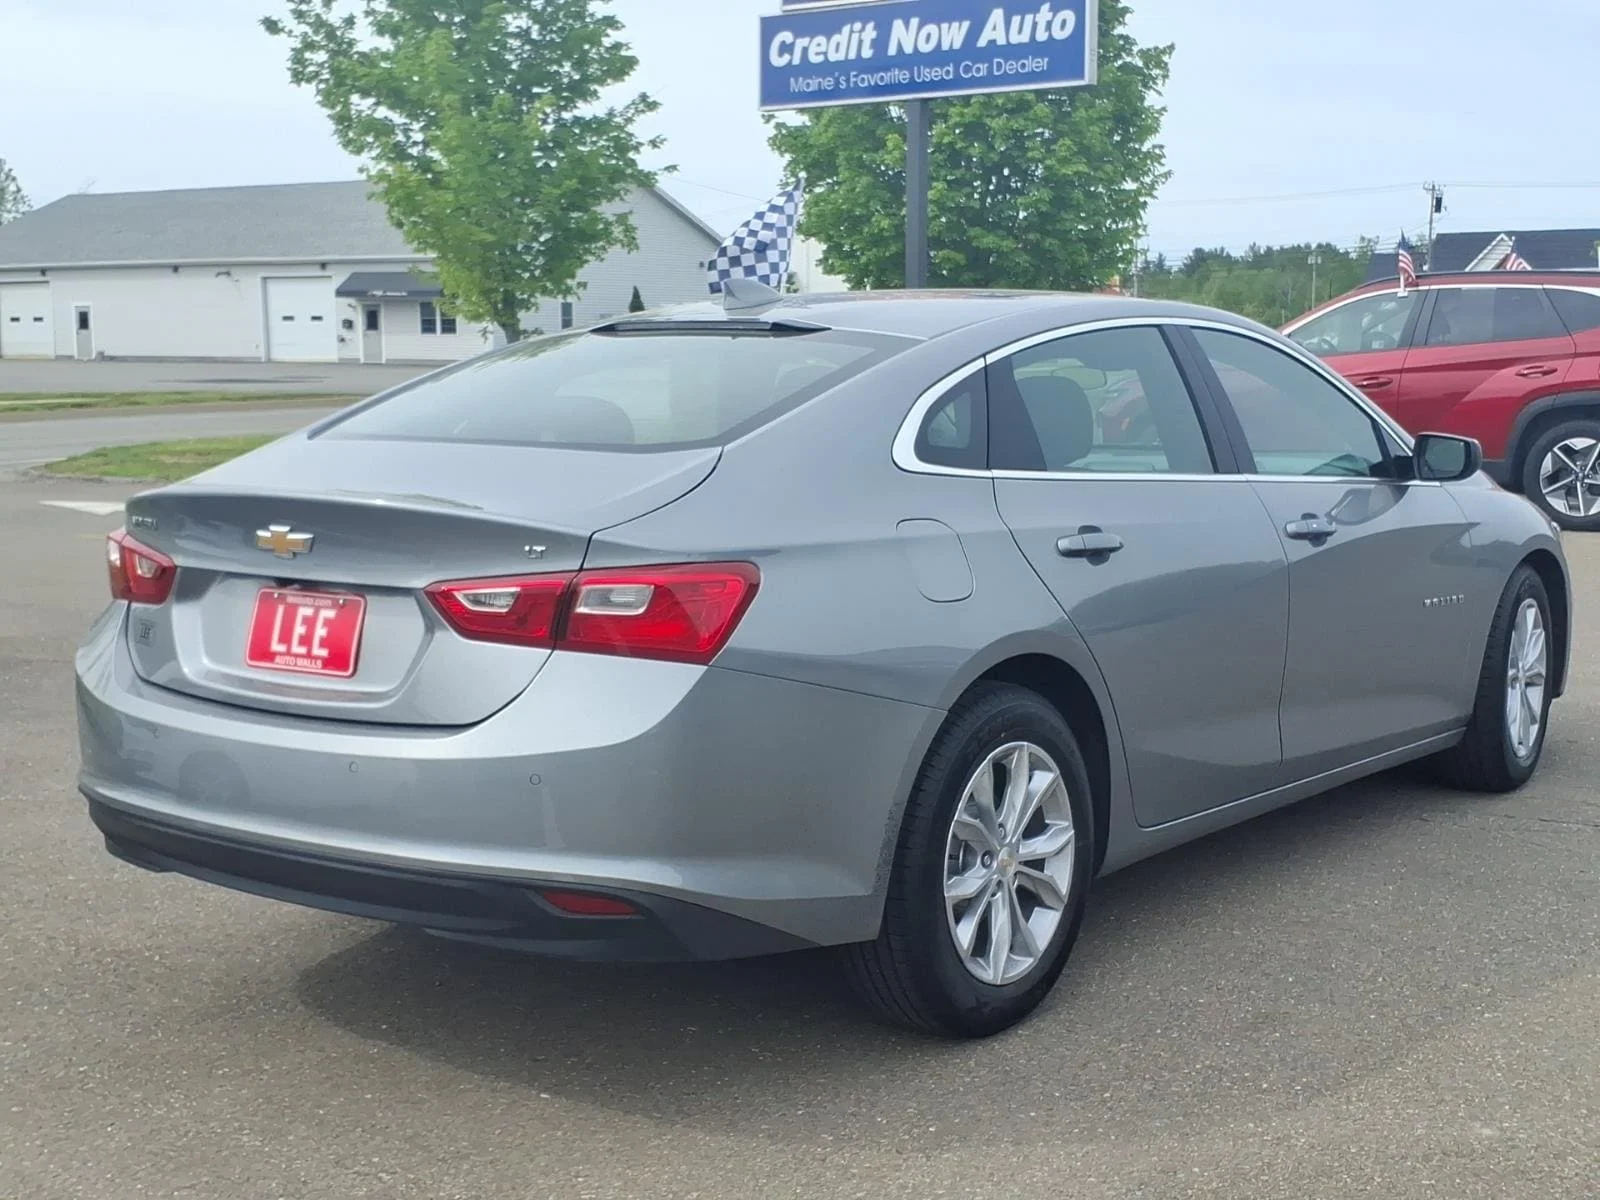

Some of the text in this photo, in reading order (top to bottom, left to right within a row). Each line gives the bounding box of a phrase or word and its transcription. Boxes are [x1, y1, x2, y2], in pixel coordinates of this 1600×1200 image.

[769, 2, 1076, 67] Credit Now Auto
[790, 56, 1049, 93] Maine's Favorite Used Car Dealer
[270, 603, 337, 658] LEE
[274, 655, 296, 666] AUTO
